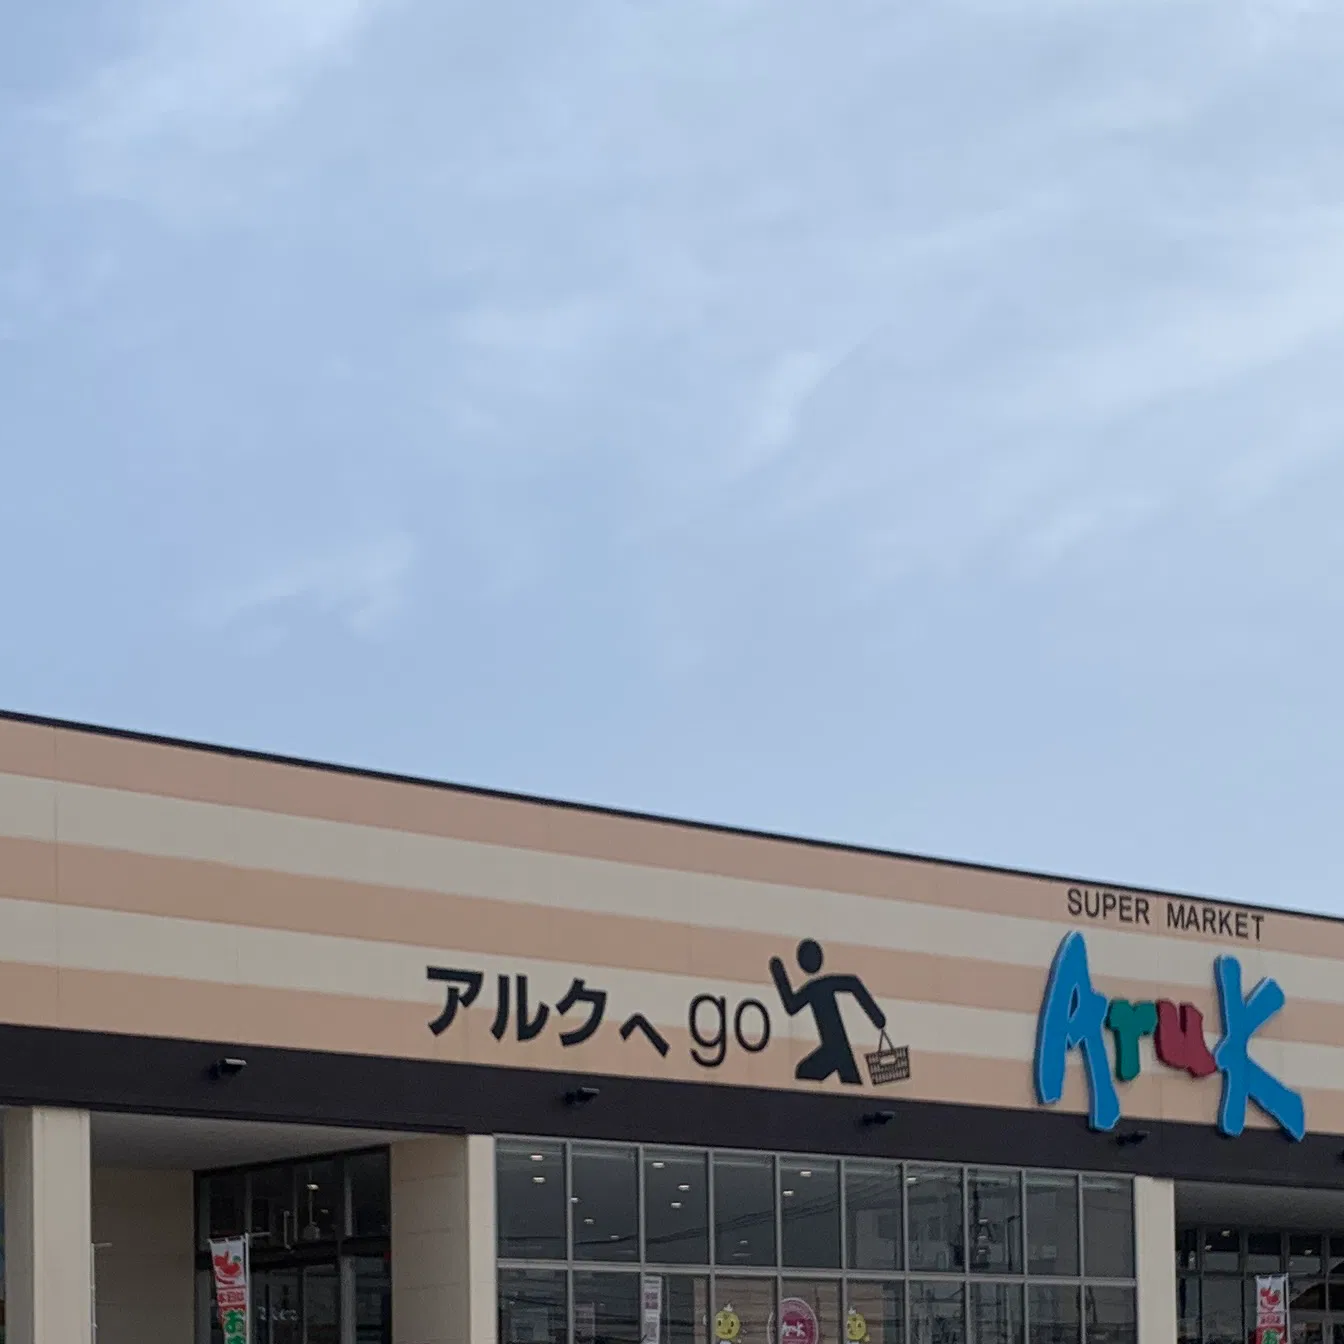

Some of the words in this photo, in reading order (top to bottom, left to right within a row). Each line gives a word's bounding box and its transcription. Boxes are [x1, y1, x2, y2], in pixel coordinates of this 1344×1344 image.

[1067, 887, 1150, 925] SUPER
[1166, 902, 1265, 941] MARKET
[689, 993, 771, 1068] go
